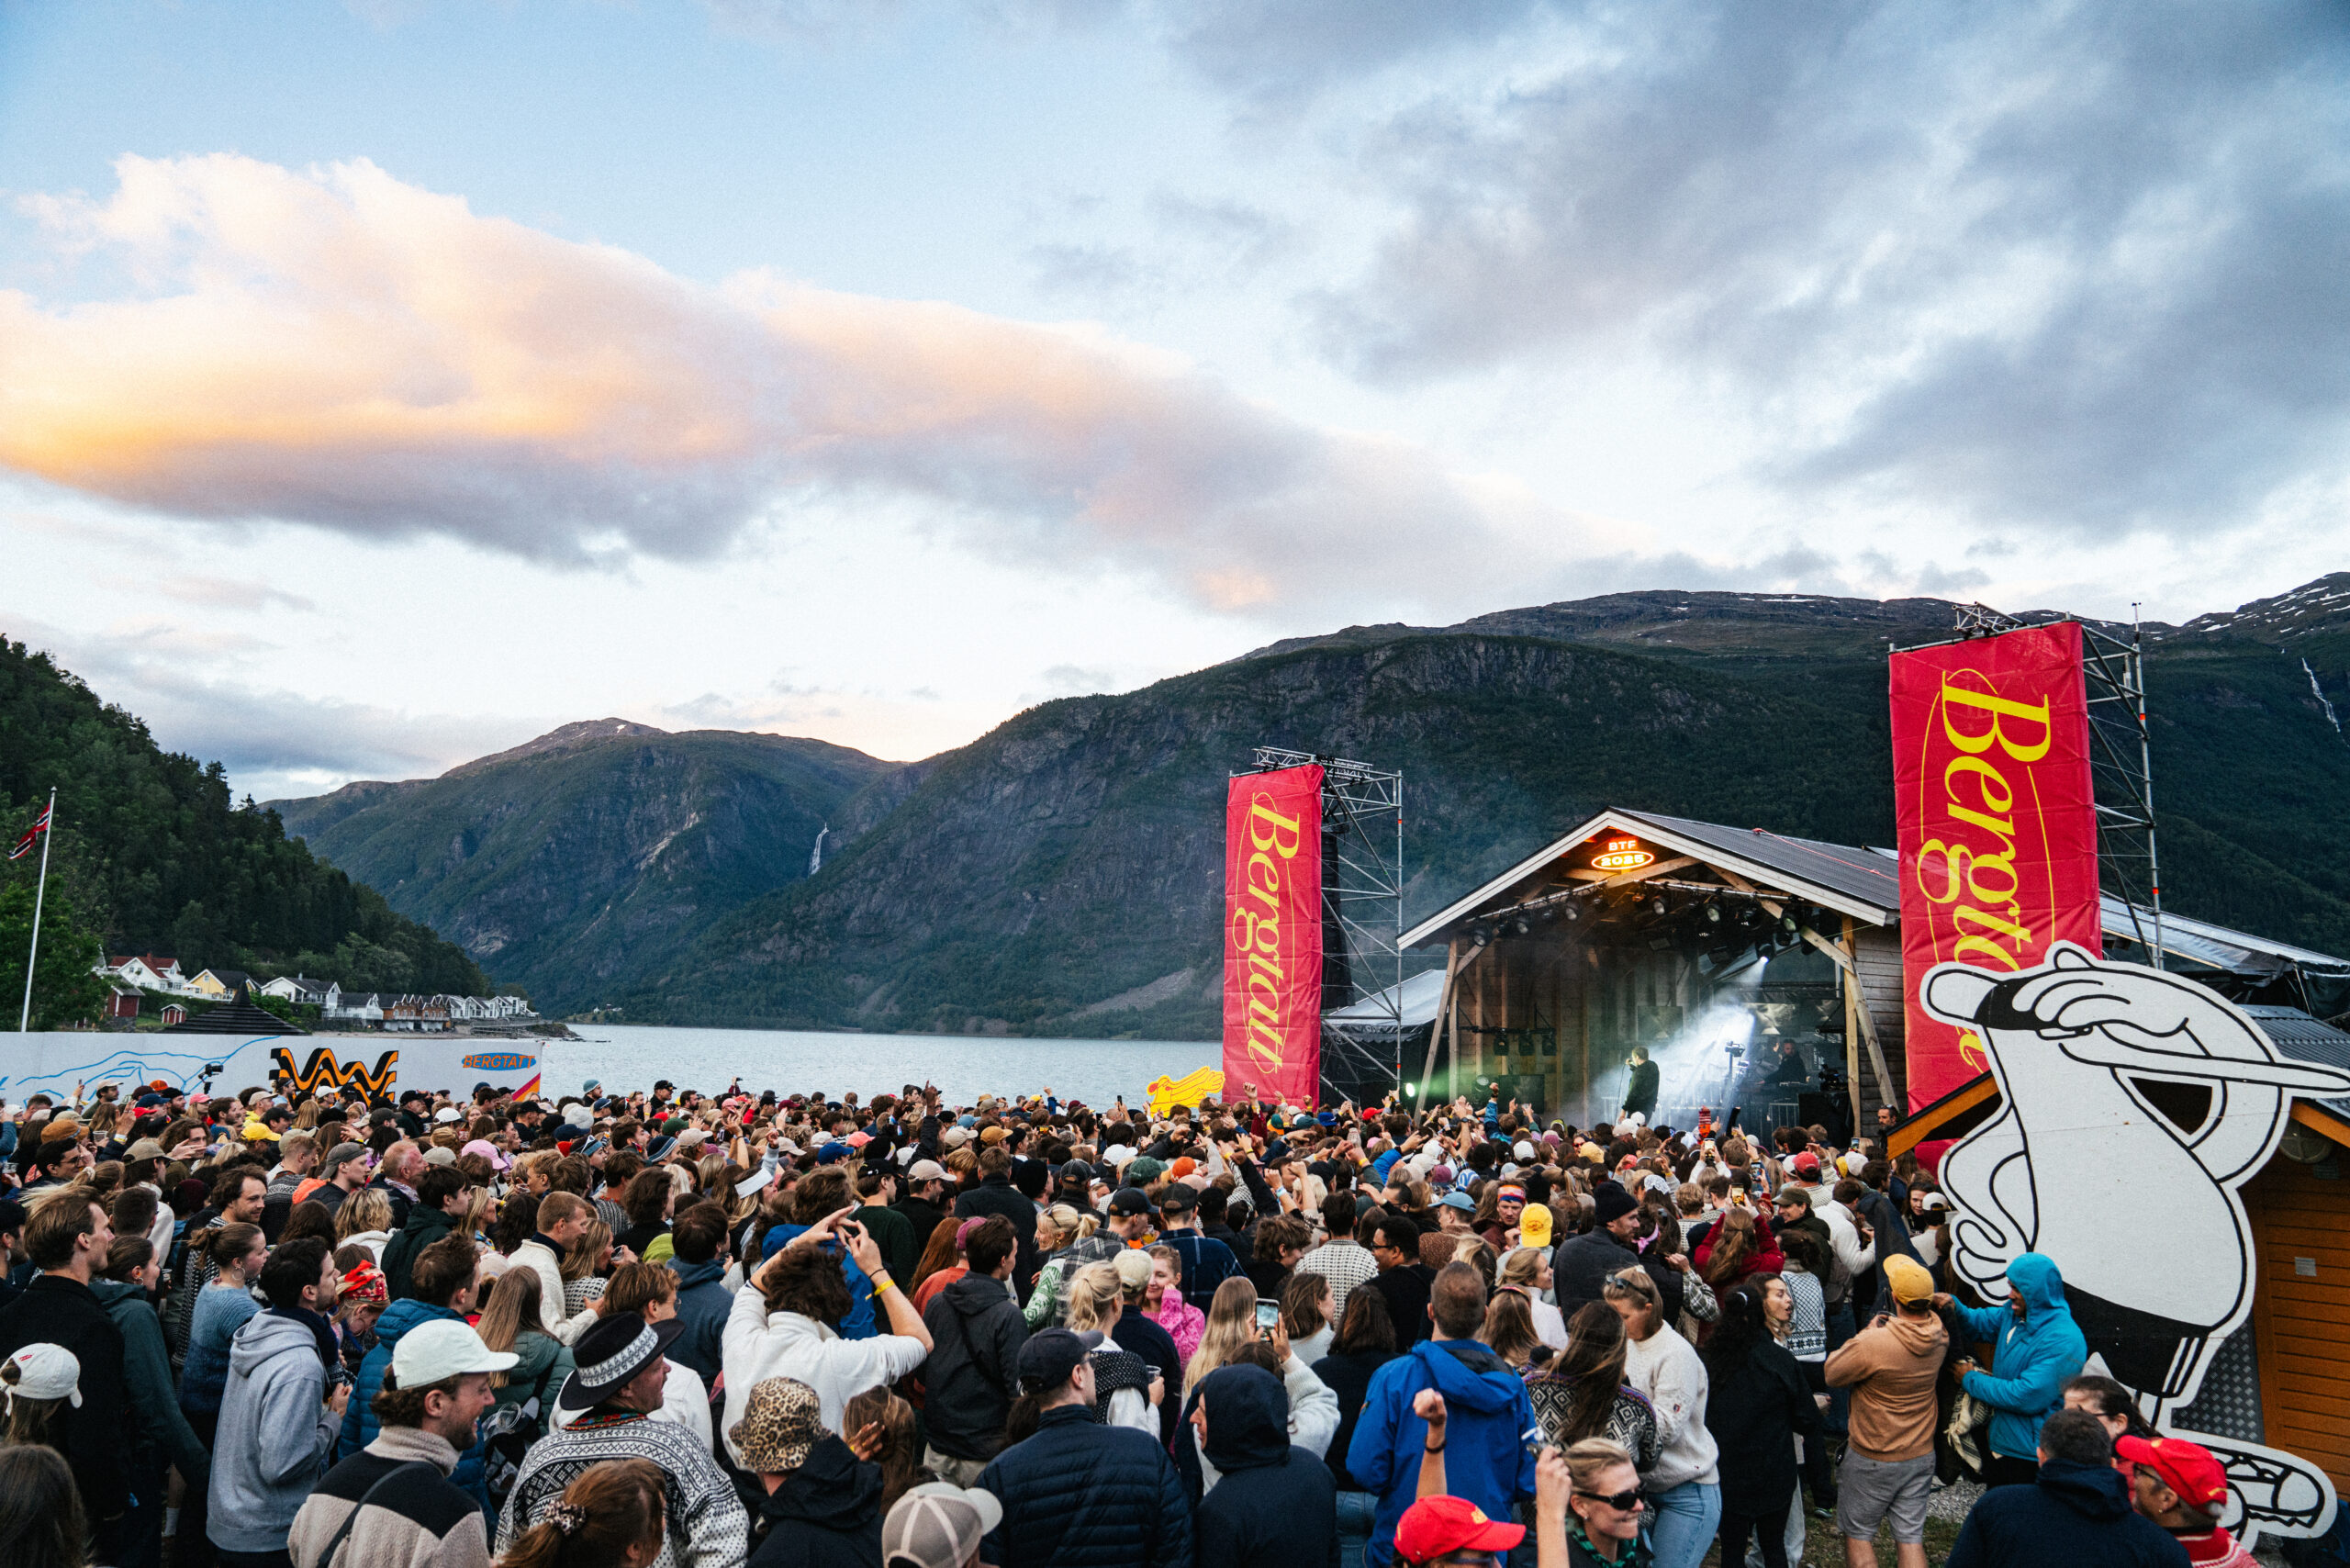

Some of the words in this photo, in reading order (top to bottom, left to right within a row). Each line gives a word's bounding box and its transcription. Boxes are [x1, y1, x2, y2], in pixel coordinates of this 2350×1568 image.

[1608, 839, 1637, 852] BTF
[1600, 854, 1645, 867] 2025
[1232, 791, 1300, 1074] Bergtatt
[462, 1055, 535, 1069] BERGTATT
